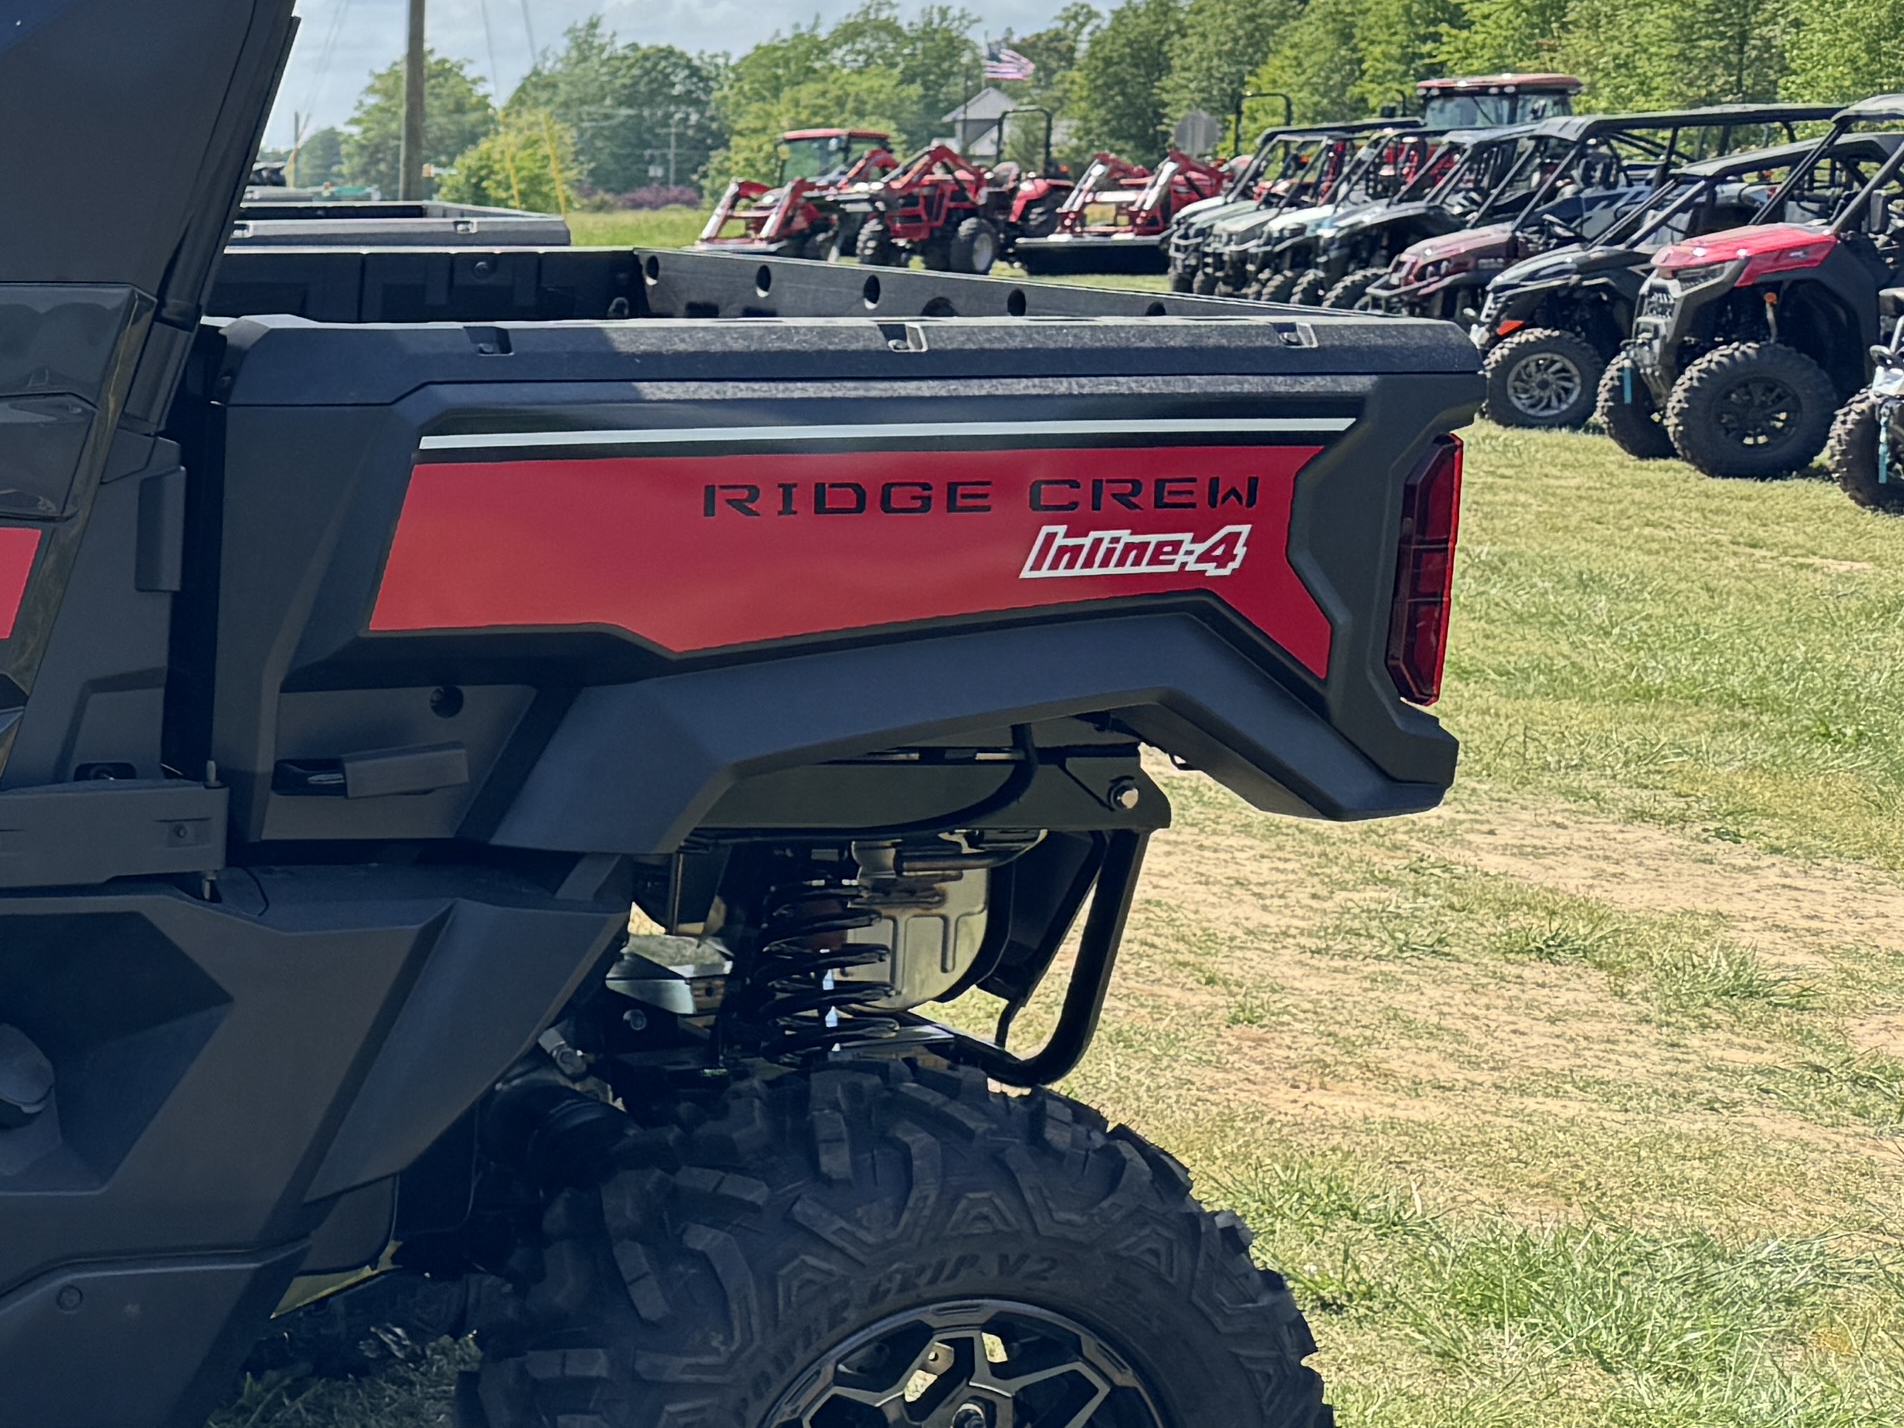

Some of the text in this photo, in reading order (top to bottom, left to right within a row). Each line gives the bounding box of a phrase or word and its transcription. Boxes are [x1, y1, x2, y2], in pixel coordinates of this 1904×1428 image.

[703, 476, 1260, 518] RIDGE CREW
[1019, 524, 1253, 579] Inline-4
[996, 1252, 1061, 1282] V2
